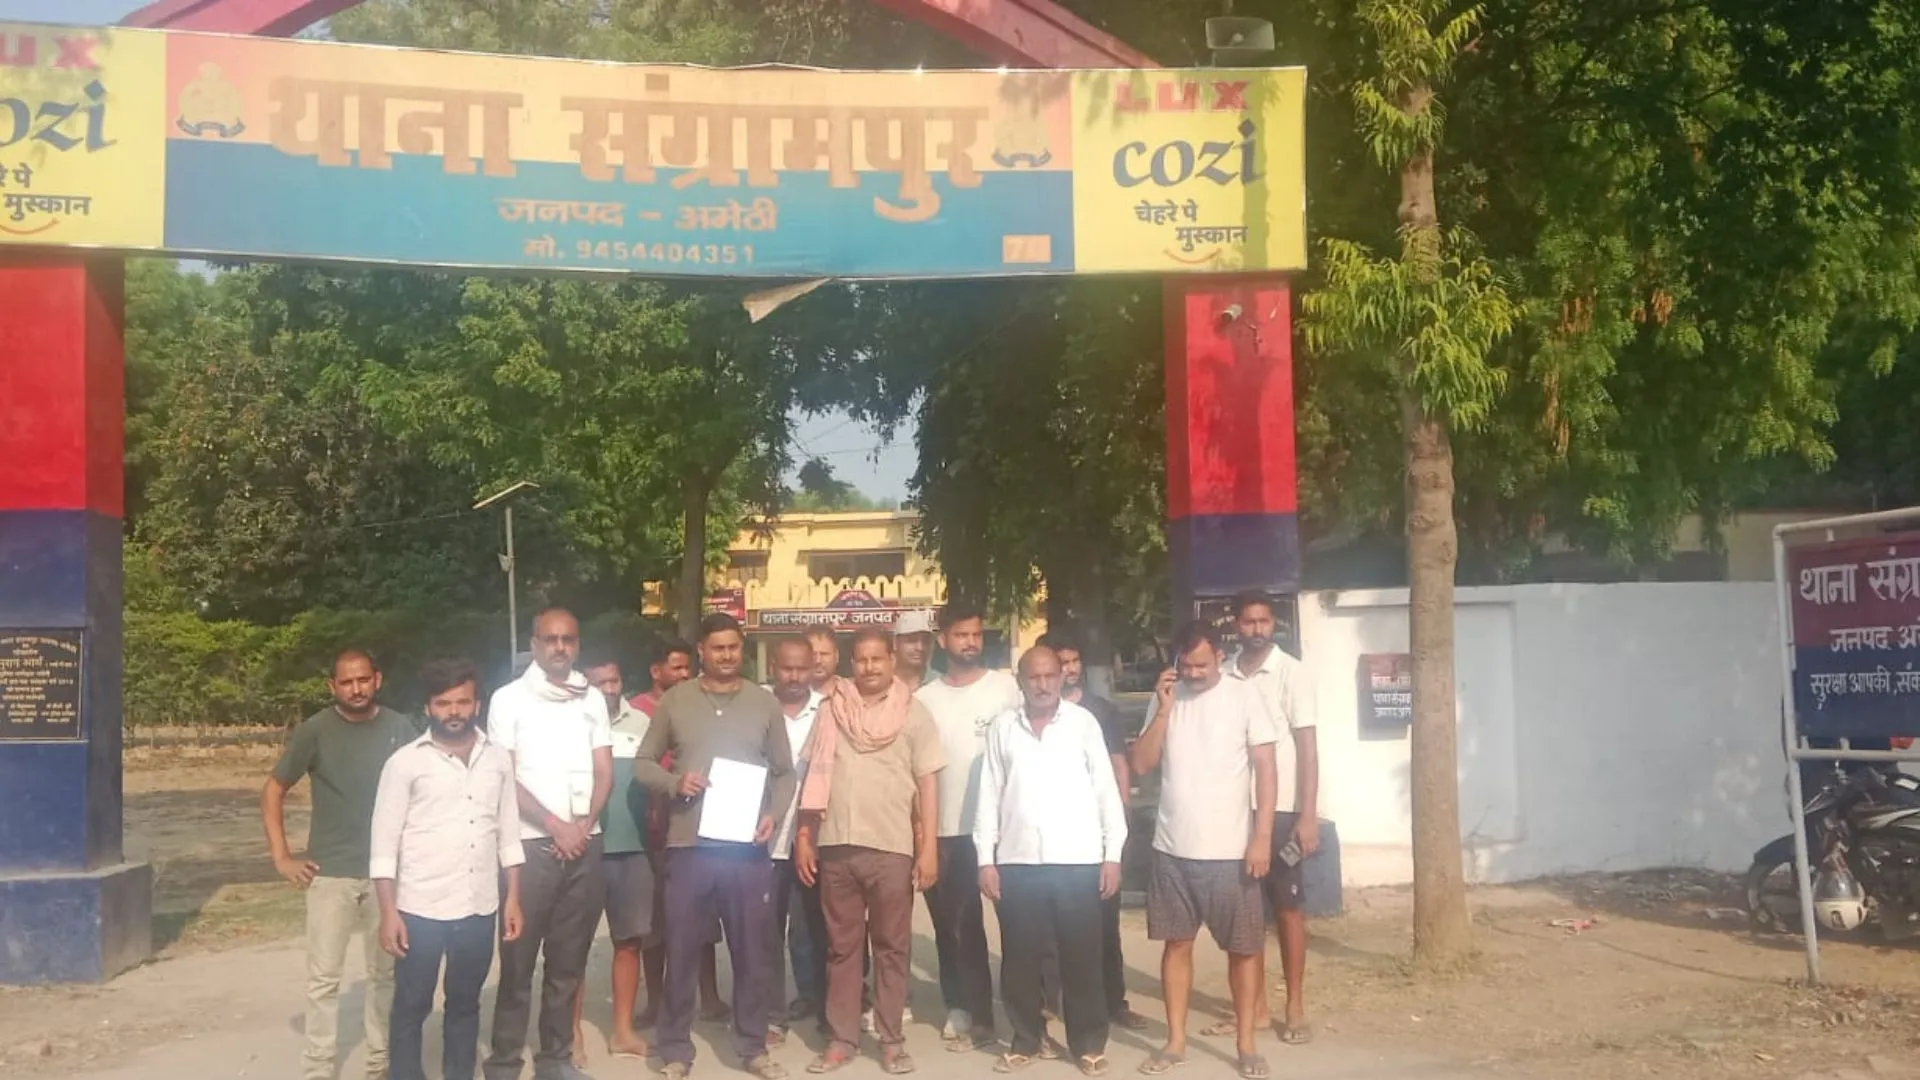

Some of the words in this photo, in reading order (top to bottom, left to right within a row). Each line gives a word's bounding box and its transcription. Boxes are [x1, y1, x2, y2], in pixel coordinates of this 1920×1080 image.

[0, 34, 103, 69] UX
[1113, 80, 1249, 113] LUX
[0, 79, 117, 153] ozi
[267, 75, 525, 178] थाना
[560, 72, 990, 223] संग्रामपुर
[1112, 119, 1266, 188] cozi
[3, 193, 92, 221] मुस्कान
[496, 198, 627, 227] जनपद
[673, 196, 779, 231] अमेठी
[1134, 199, 1178, 224] चेहरे
[1181, 198, 1198, 222] पे
[576, 240, 755, 264] 9454404351
[1175, 225, 1248, 252] मुस्कान
[1800, 564, 1859, 605] थाना
[1829, 626, 1892, 653] जनपद
